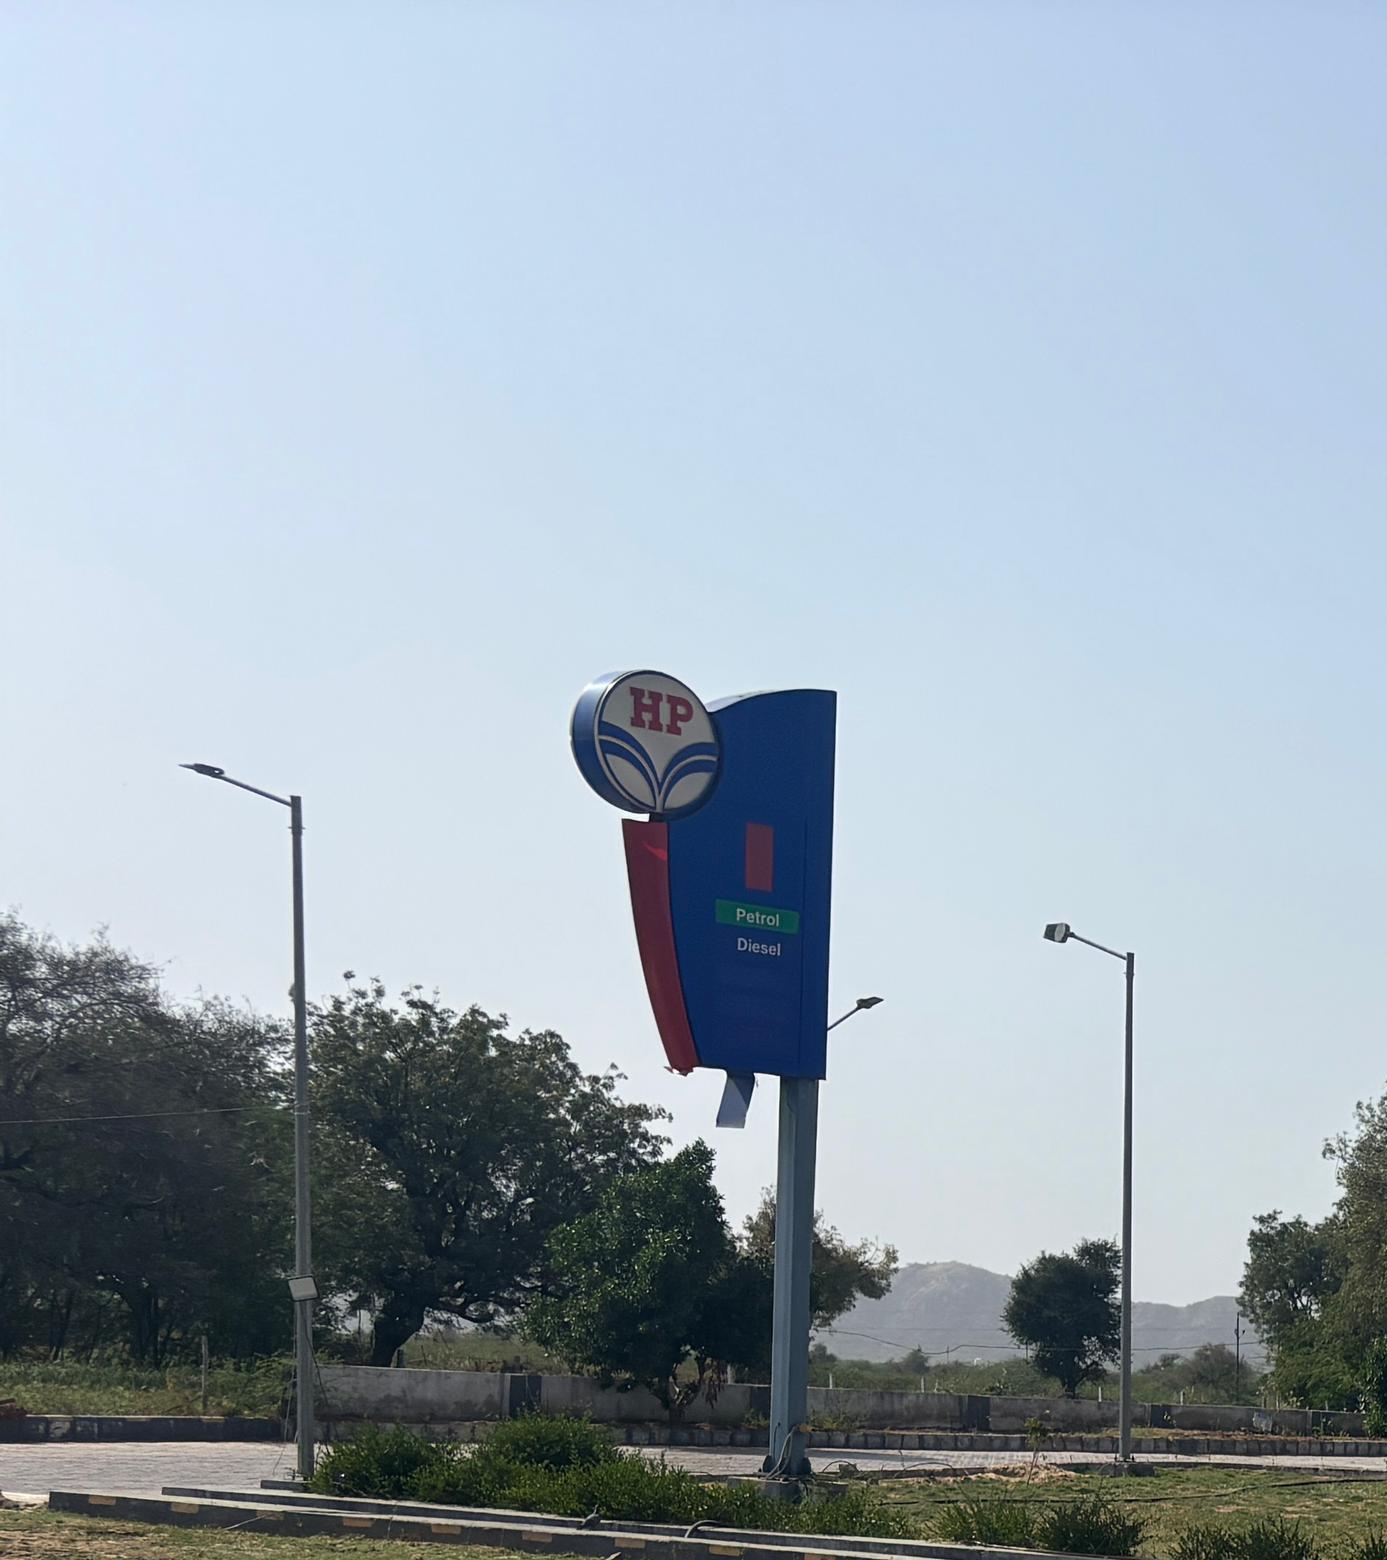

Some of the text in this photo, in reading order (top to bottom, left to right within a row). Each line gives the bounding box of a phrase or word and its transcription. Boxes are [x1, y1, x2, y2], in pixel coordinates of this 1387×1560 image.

[629, 686, 694, 735] HP
[736, 908, 780, 927] Petrol
[737, 938, 781, 957] Diesel
